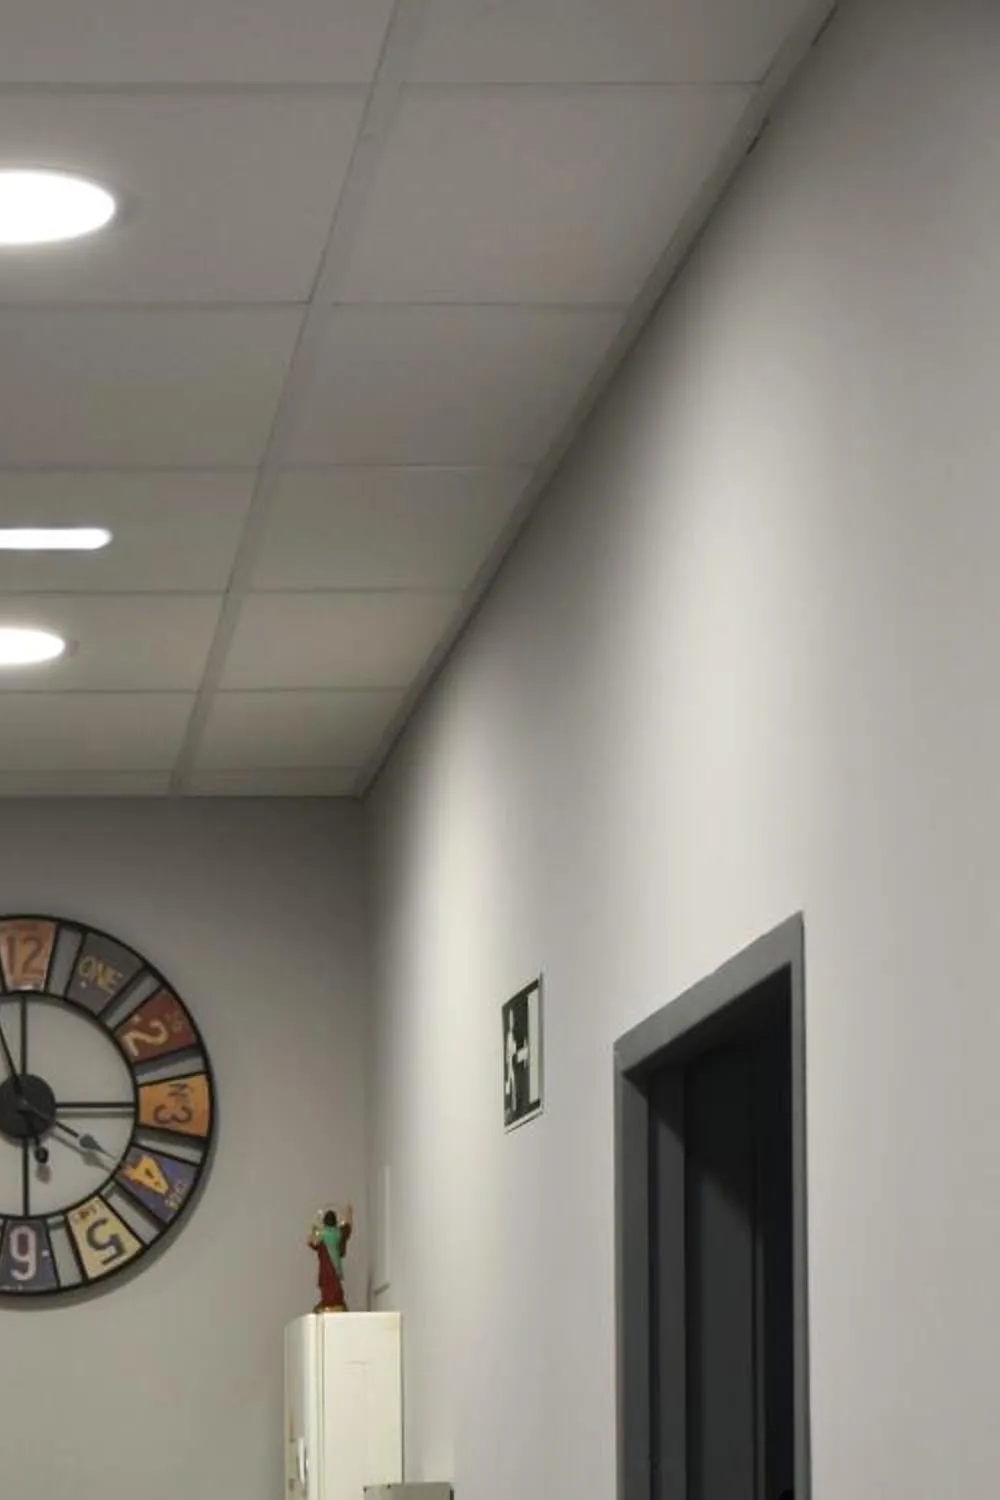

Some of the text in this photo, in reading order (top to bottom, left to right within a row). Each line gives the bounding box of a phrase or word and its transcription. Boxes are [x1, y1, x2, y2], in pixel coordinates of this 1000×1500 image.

[5, 936, 46, 980] 12
[78, 957, 123, 996] ONE
[122, 1017, 169, 1057] 2
[122, 1154, 169, 1196] 4
[86, 1217, 127, 1266] 5
